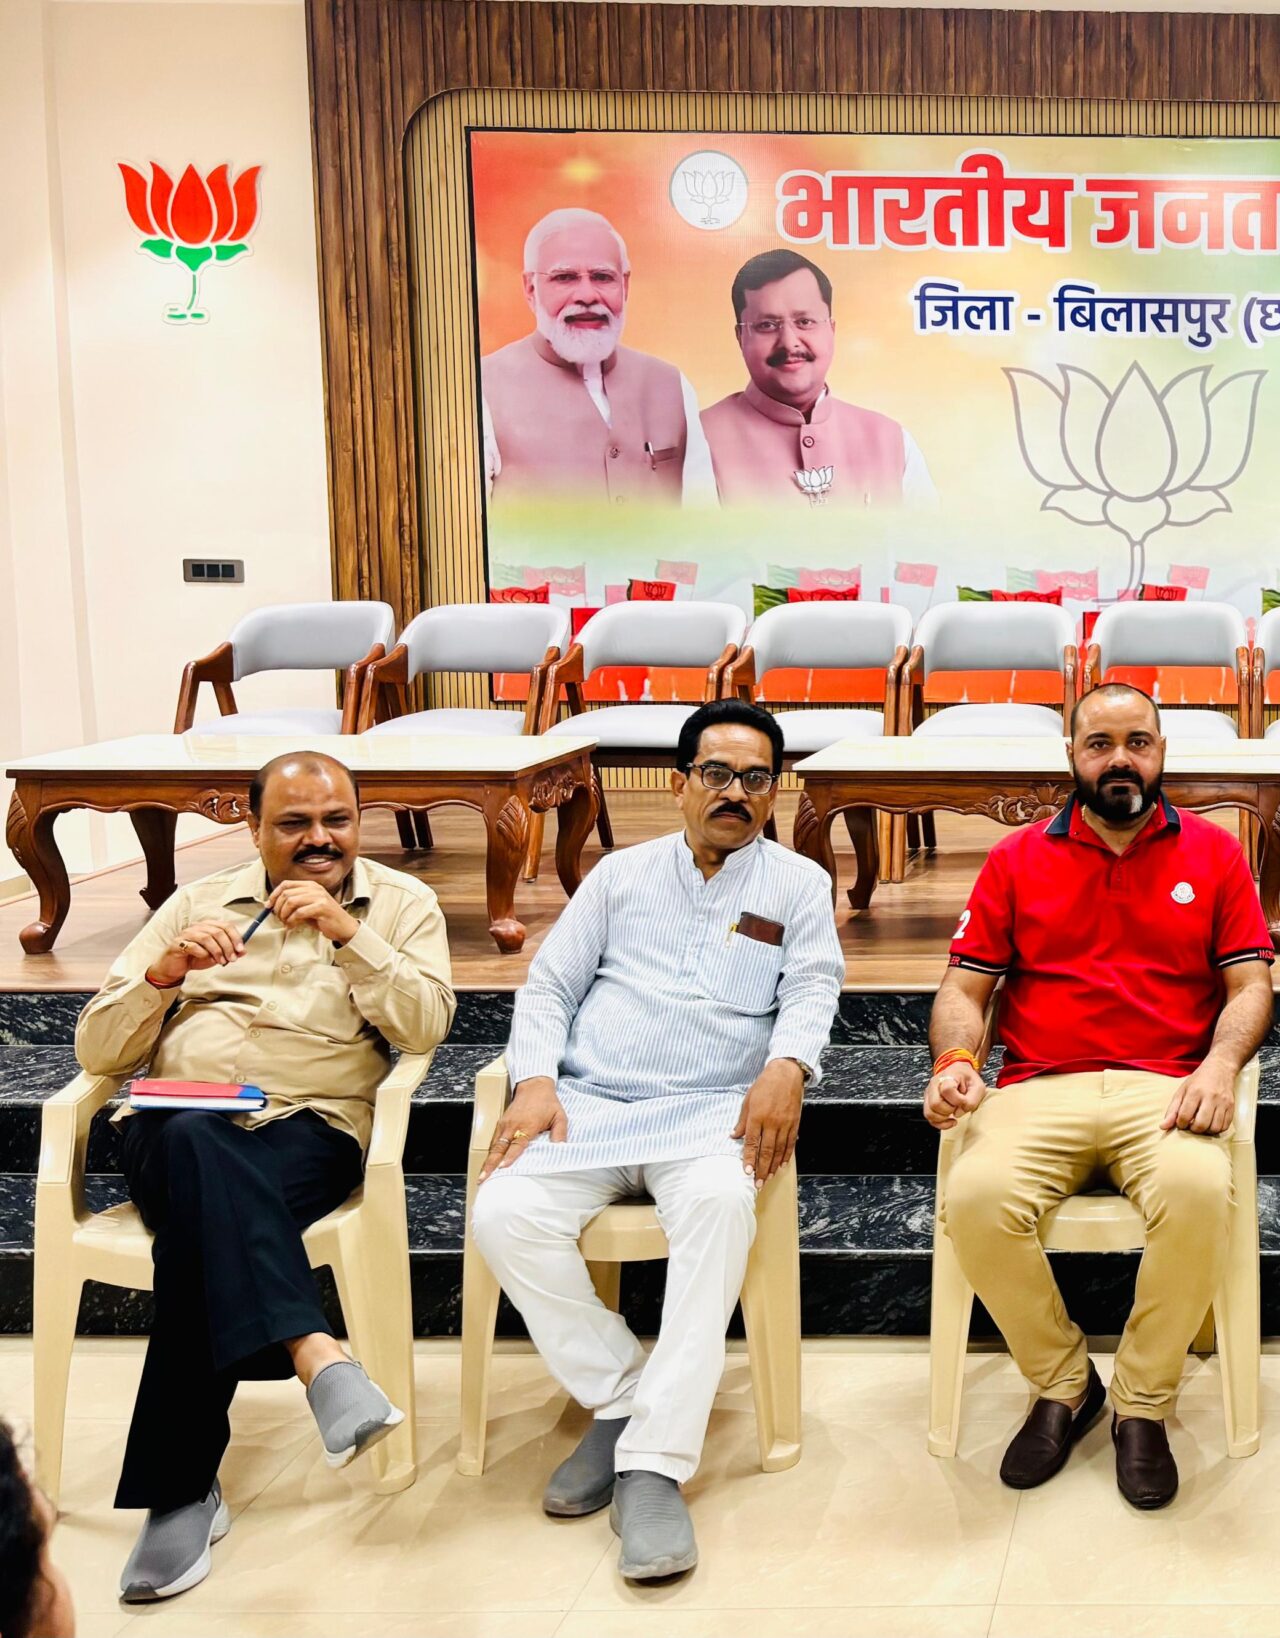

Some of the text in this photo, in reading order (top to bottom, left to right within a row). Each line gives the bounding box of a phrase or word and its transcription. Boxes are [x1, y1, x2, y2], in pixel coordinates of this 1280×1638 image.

[782, 153, 1074, 248] भारतीय
[914, 284, 1014, 330] जिला
[1053, 285, 1231, 346] बिलासपुर
[951, 909, 971, 939] 2
